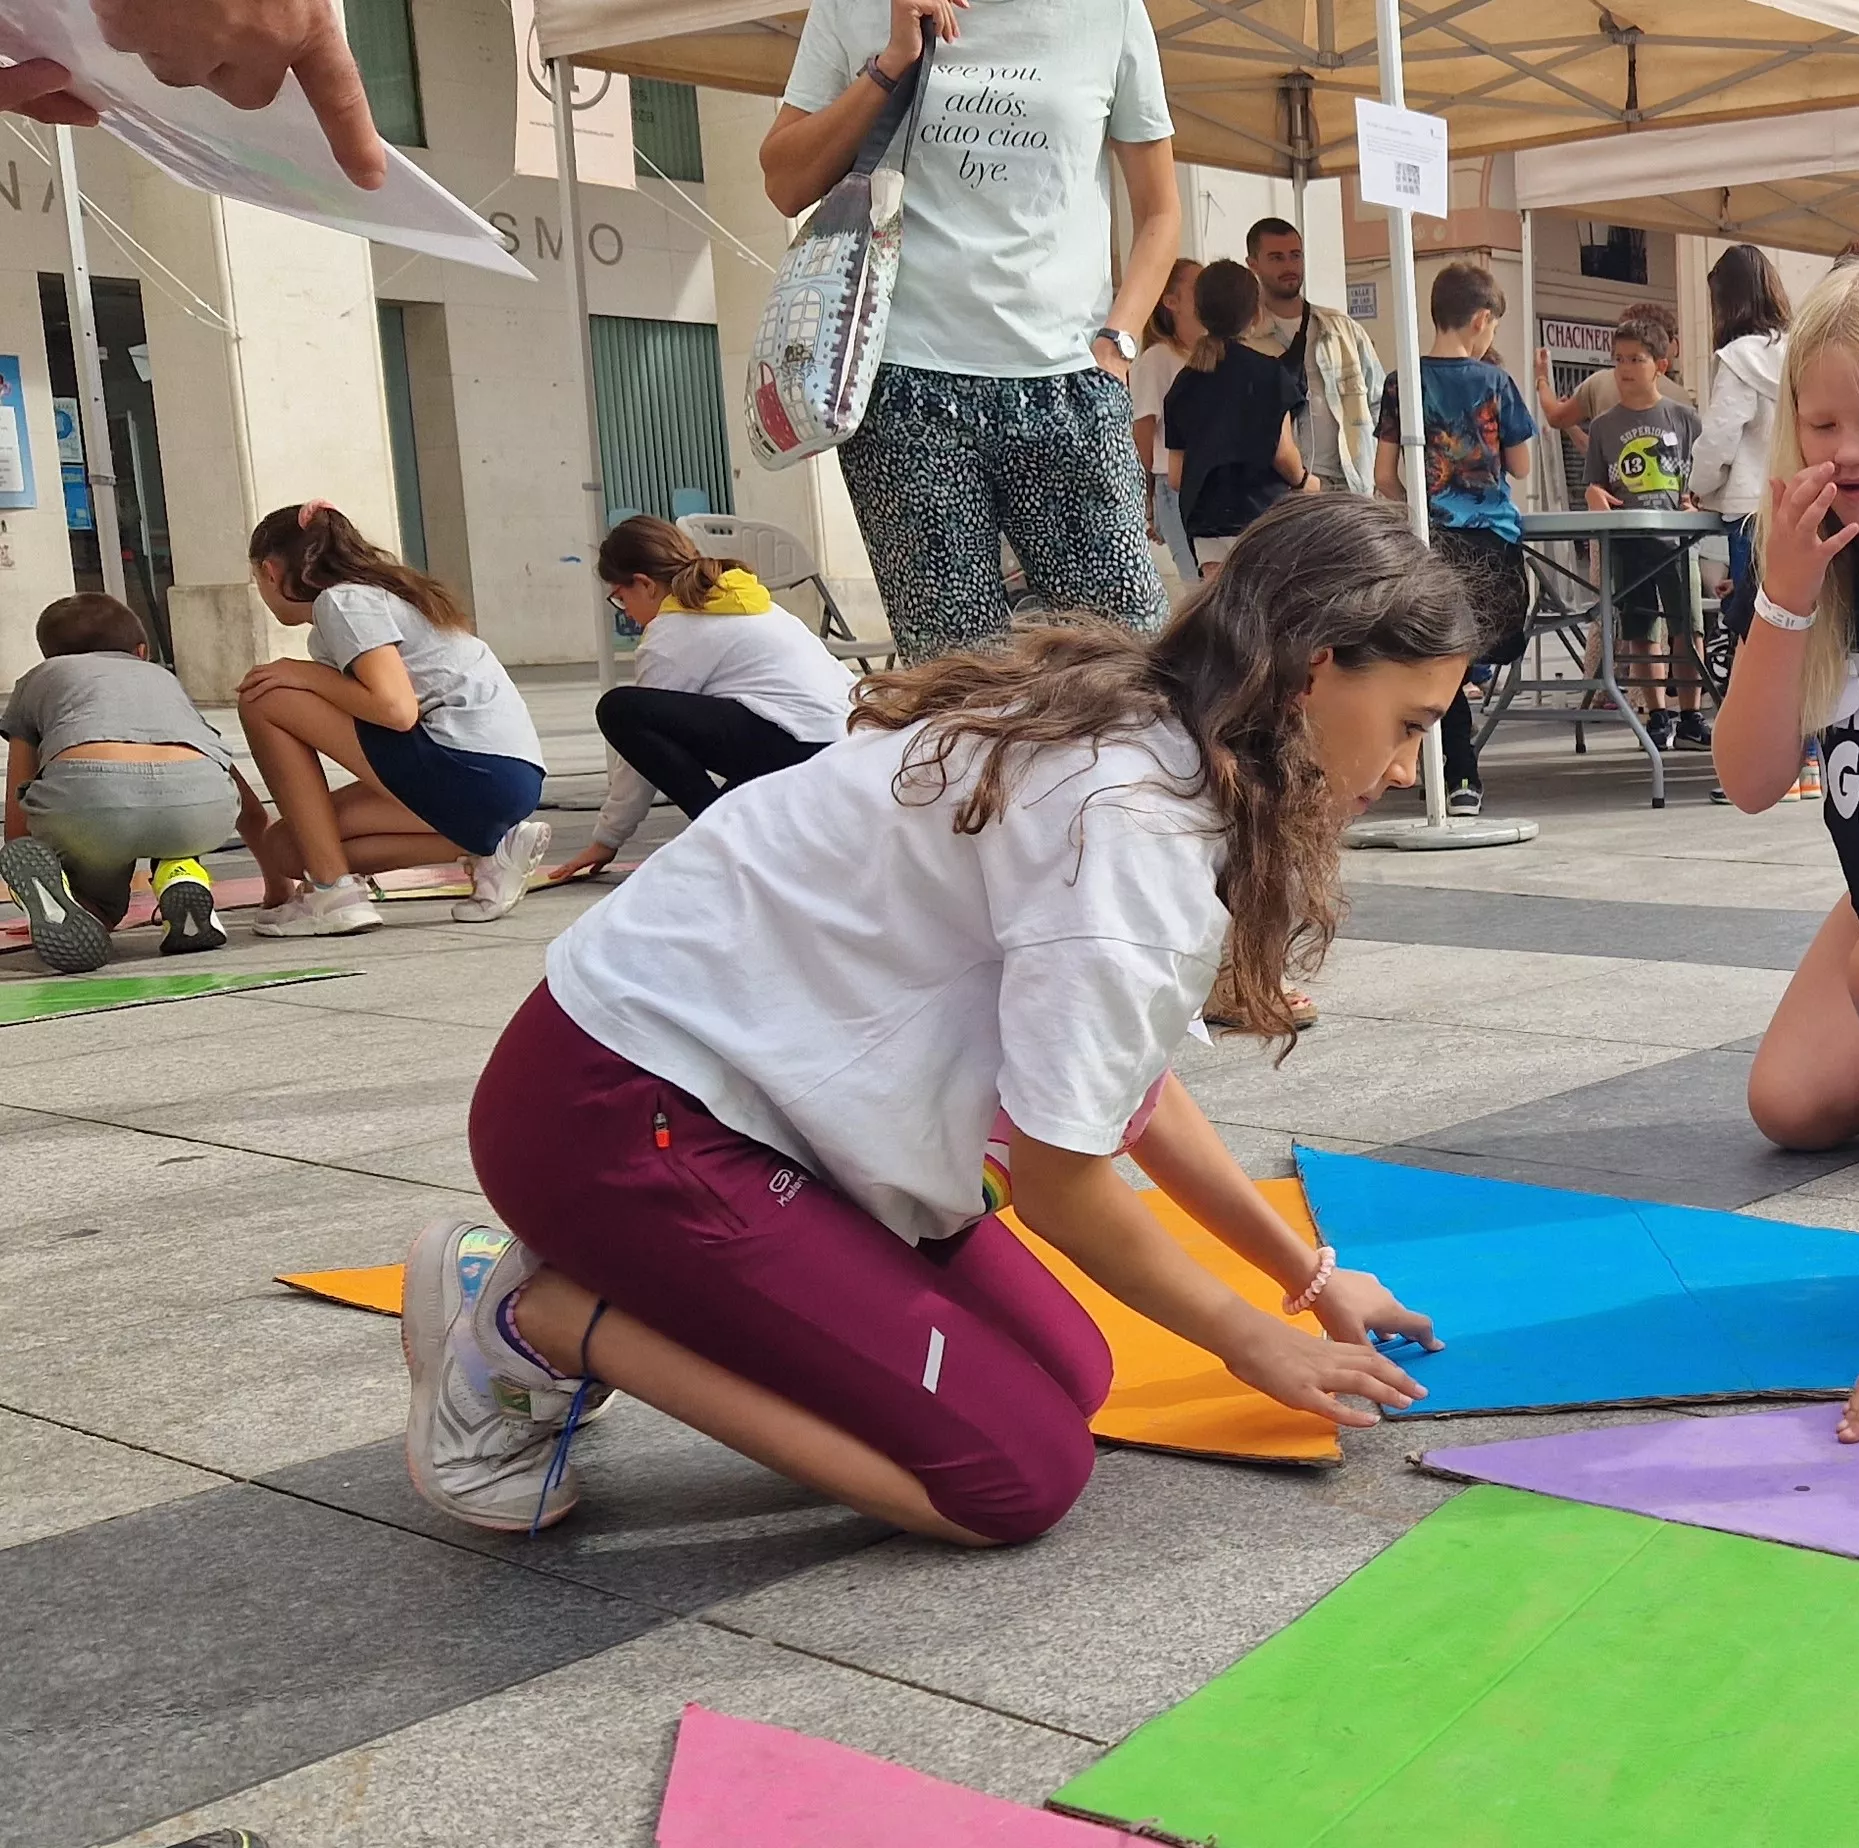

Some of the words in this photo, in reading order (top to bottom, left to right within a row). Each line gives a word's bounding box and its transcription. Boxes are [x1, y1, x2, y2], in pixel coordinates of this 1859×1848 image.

[936, 65, 978, 79] see
[980, 66, 1042, 83] you.
[945, 86, 1027, 118] adiós.
[920, 116, 980, 144] ciao
[988, 122, 1049, 149] ciao.
[959, 150, 1008, 189] bye.
[1623, 457, 1643, 475] 13
